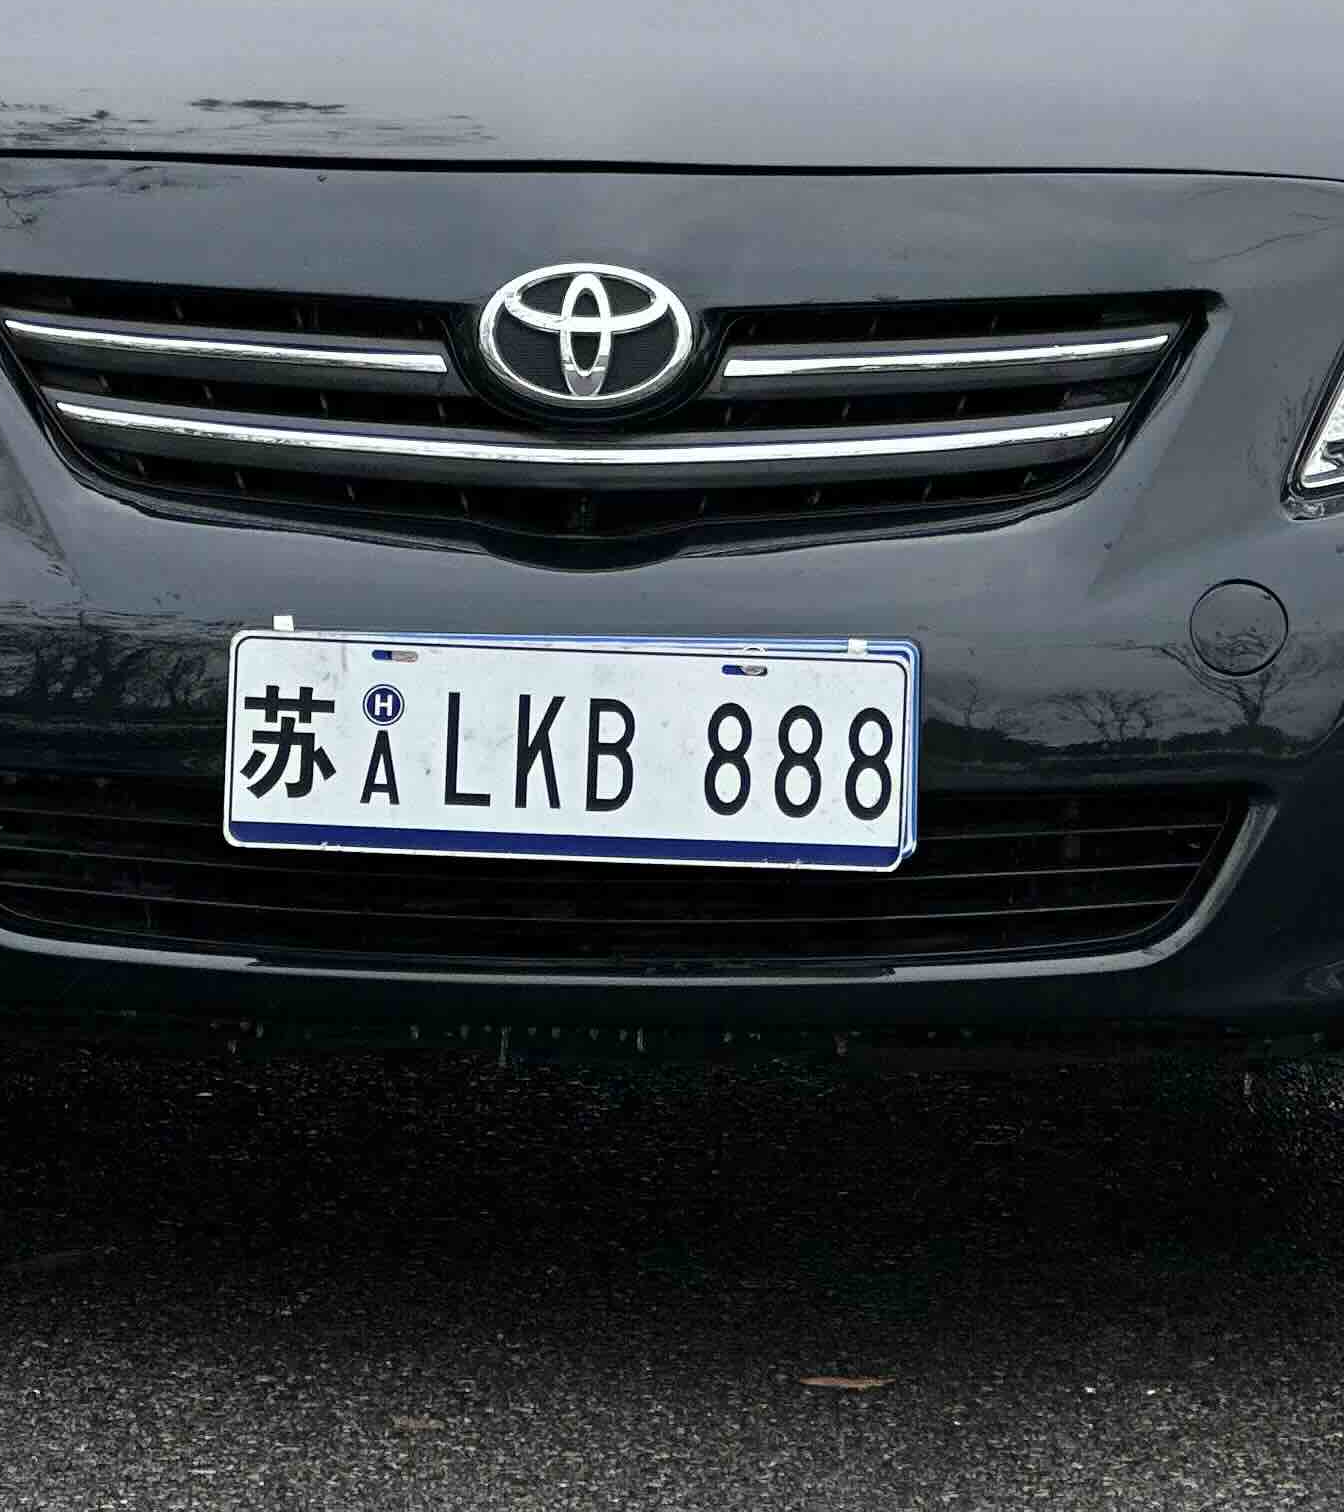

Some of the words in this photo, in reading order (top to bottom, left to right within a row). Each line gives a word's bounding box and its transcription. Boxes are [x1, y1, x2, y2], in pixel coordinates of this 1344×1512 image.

[374, 693, 394, 717] H
[240, 684, 337, 800] 苏
[359, 729, 400, 805] A
[444, 691, 636, 812] LKB
[704, 702, 893, 821] 888
